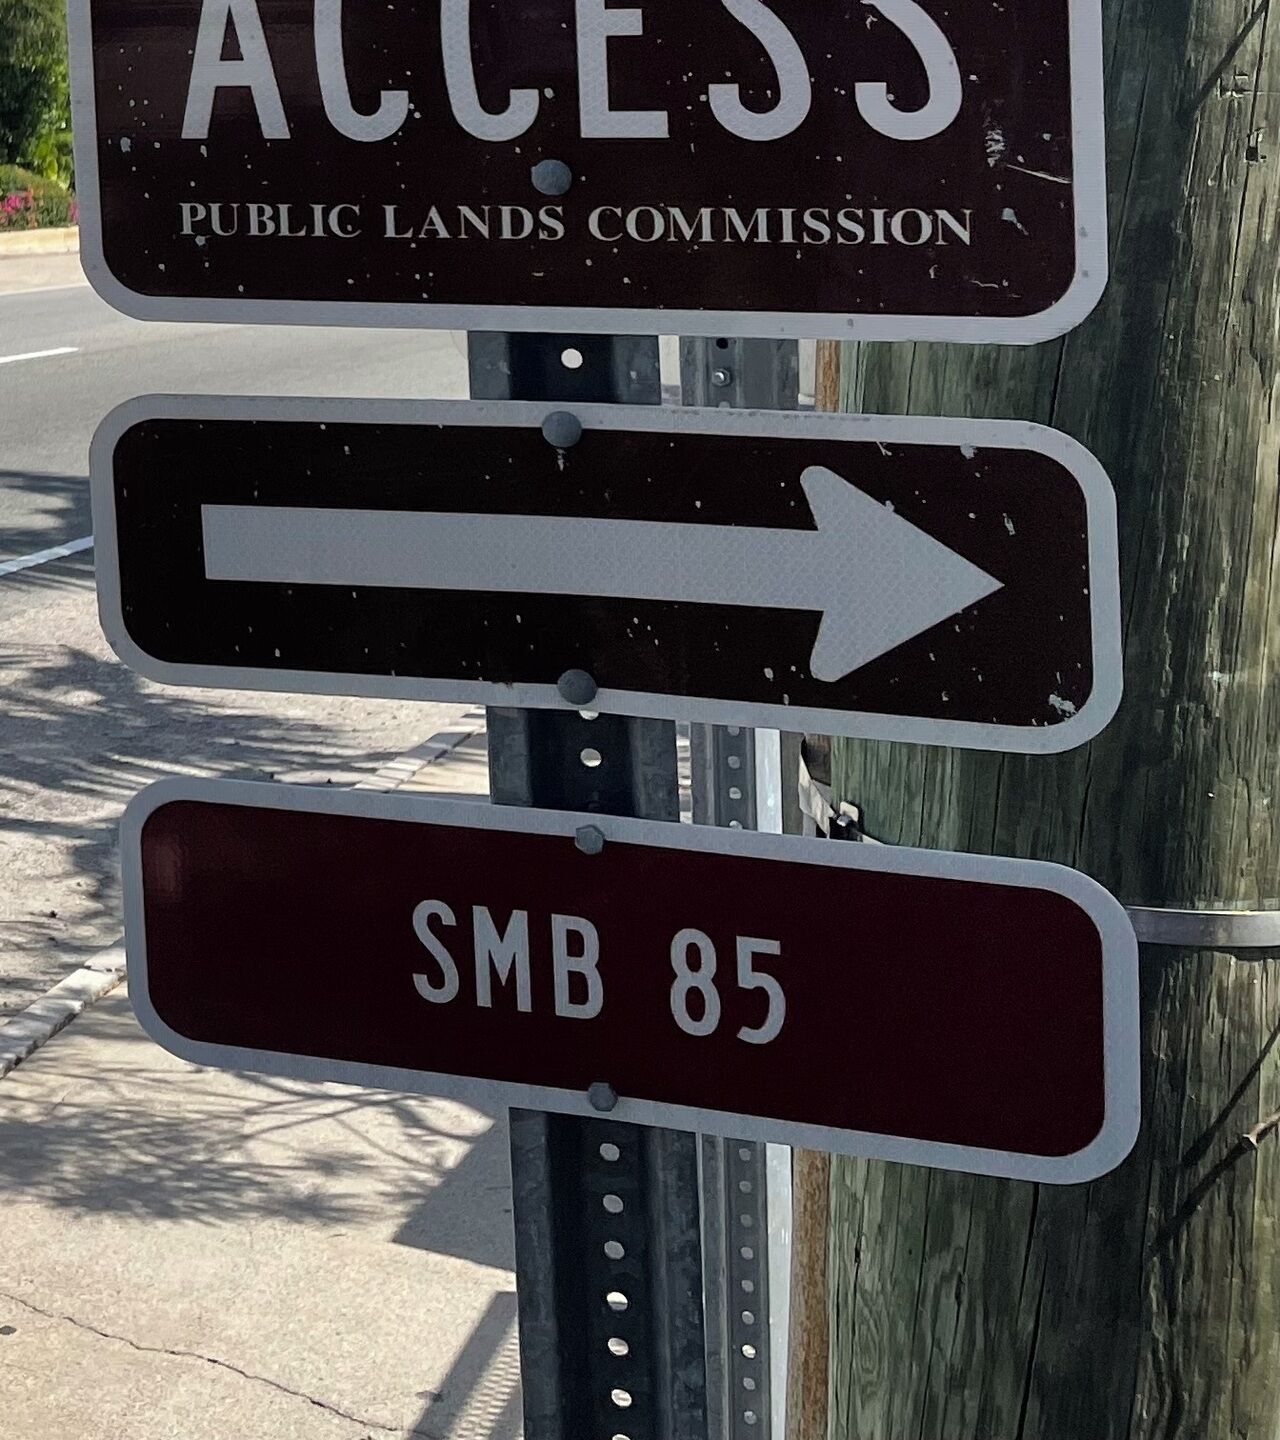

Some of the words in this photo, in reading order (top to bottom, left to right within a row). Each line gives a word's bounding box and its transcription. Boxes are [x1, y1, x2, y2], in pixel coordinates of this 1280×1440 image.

[178, 202, 362, 239] PUBLIC
[383, 204, 566, 242] LANDS
[587, 205, 973, 247] COMMISSION
[412, 899, 604, 1020] SMB
[670, 928, 787, 1045] 85
